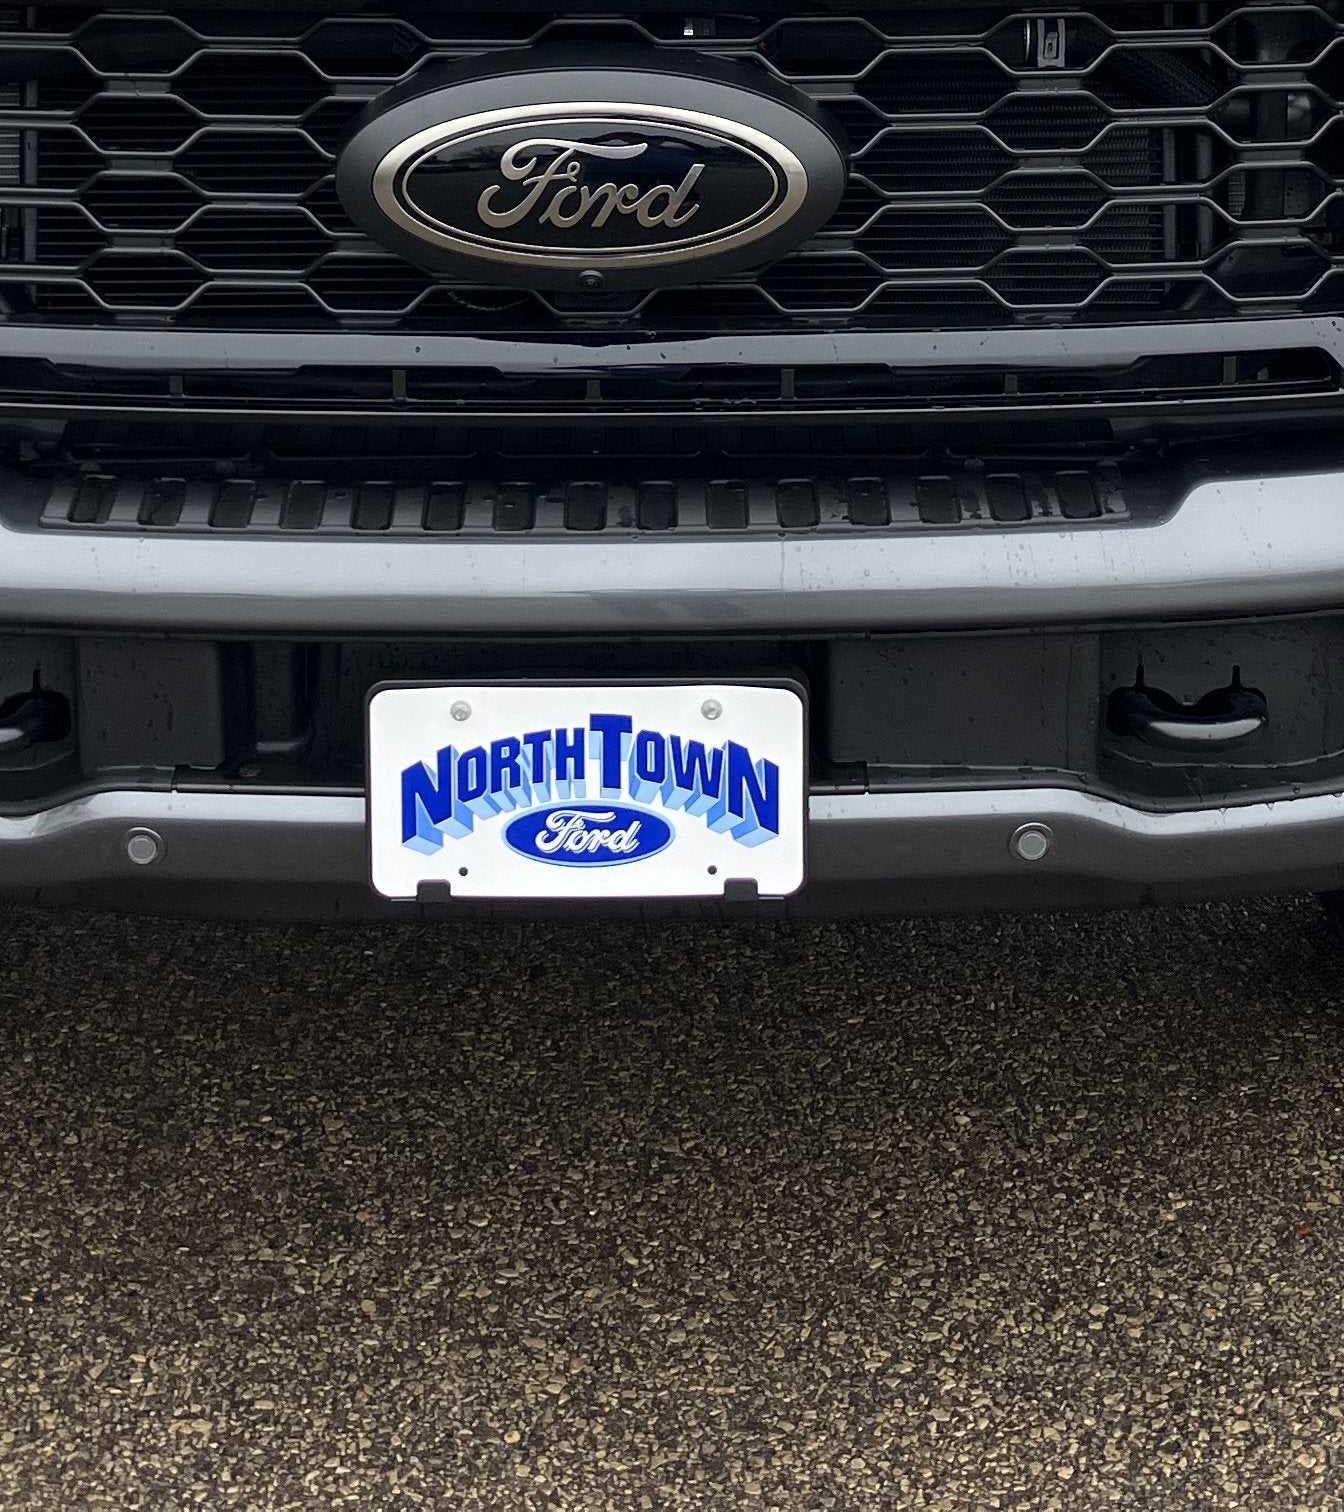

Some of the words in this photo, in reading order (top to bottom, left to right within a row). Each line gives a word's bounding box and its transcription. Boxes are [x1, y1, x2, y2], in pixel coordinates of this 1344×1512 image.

[476, 137, 706, 229] Ford
[401, 713, 780, 856] NORTHTOWN
[534, 810, 641, 855] Ford
